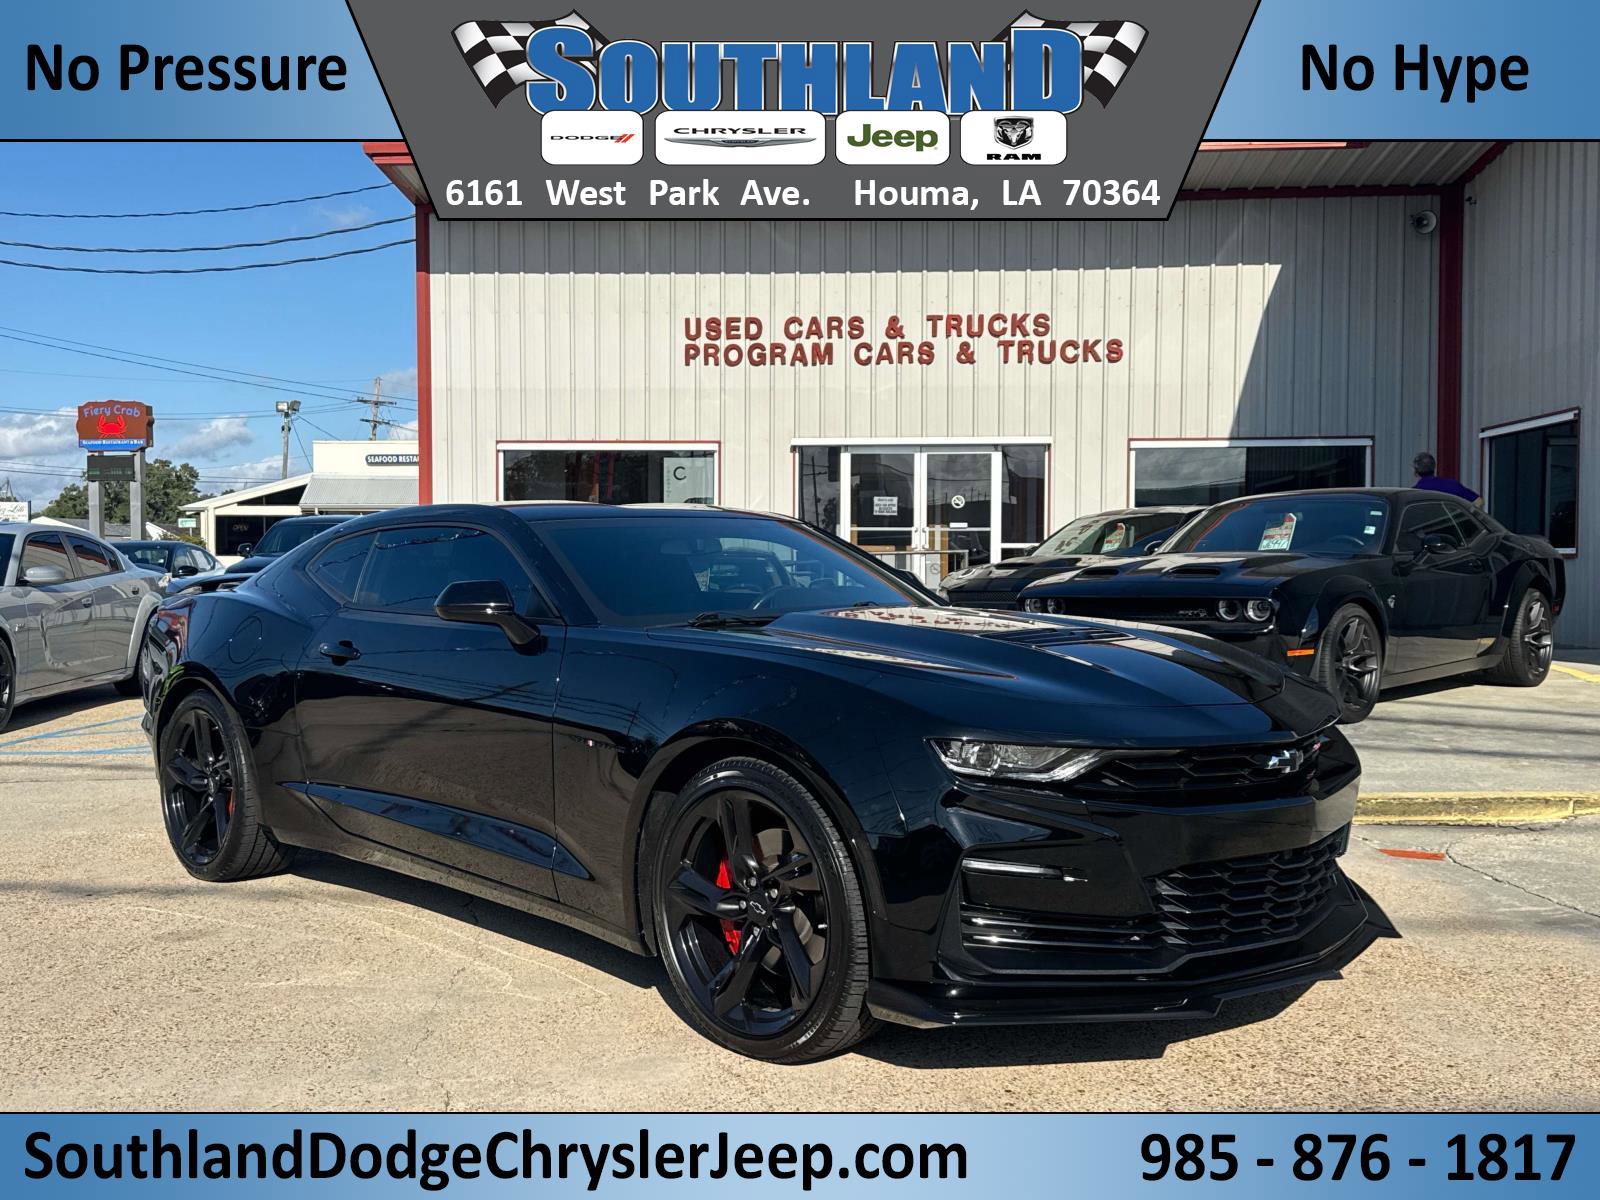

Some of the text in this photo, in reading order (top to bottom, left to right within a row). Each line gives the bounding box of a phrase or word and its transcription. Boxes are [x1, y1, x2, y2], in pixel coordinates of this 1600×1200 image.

[684, 313, 1051, 341] USED CARS & TRUCKS
[684, 339, 1124, 366] PROGRAM CARS & TRUCKS
[83, 404, 140, 417] Fiery Crab
[367, 455, 398, 463] SEAFOOD
